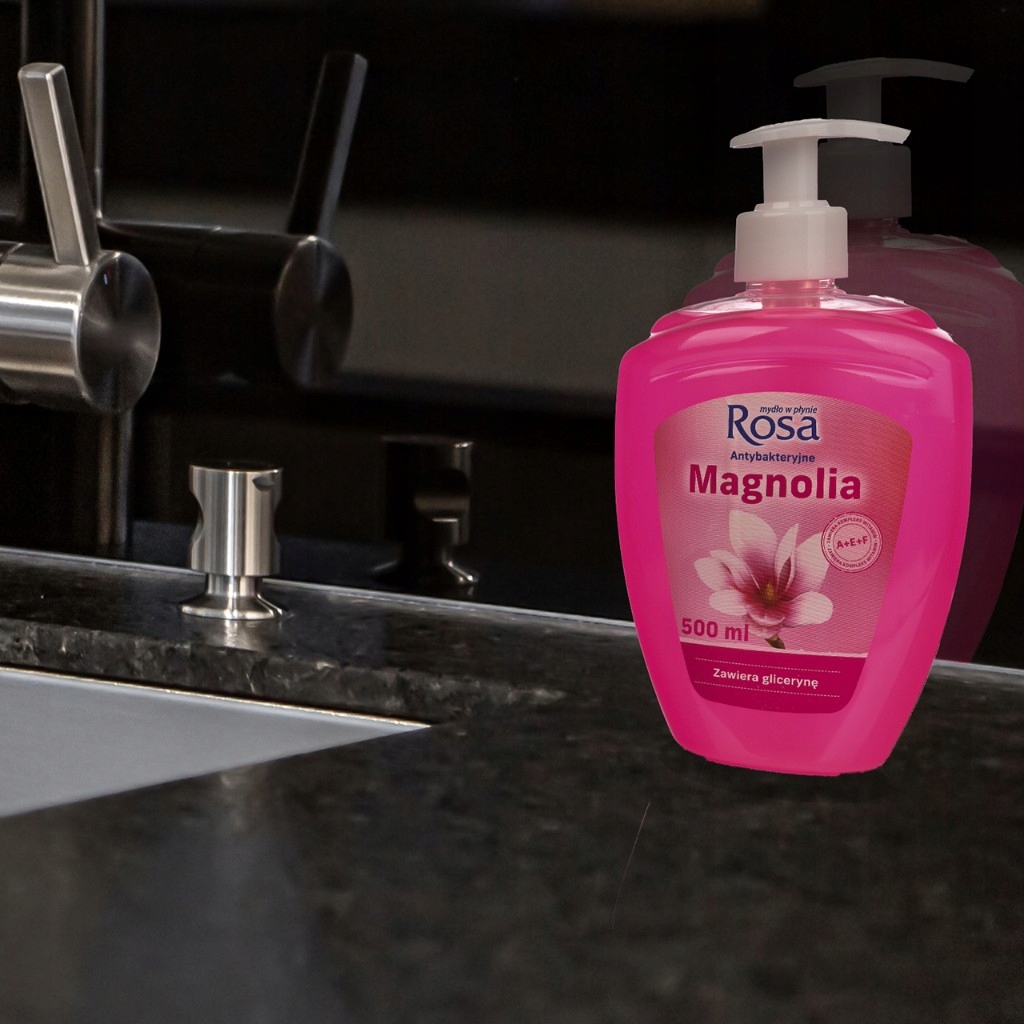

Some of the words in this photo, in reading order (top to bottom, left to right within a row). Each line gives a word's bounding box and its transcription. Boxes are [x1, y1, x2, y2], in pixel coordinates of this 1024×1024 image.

[760, 405, 783, 414] mydło
[793, 405, 818, 415] płynie
[727, 404, 820, 446] Rosa
[730, 450, 816, 464] Antybakteryjne
[689, 463, 861, 505] Magnolia
[836, 535, 868, 549] A+E+F
[681, 617, 718, 638] 500
[724, 624, 749, 642] ml
[712, 668, 759, 683] Zawiera
[762, 673, 819, 690] glicerynę
